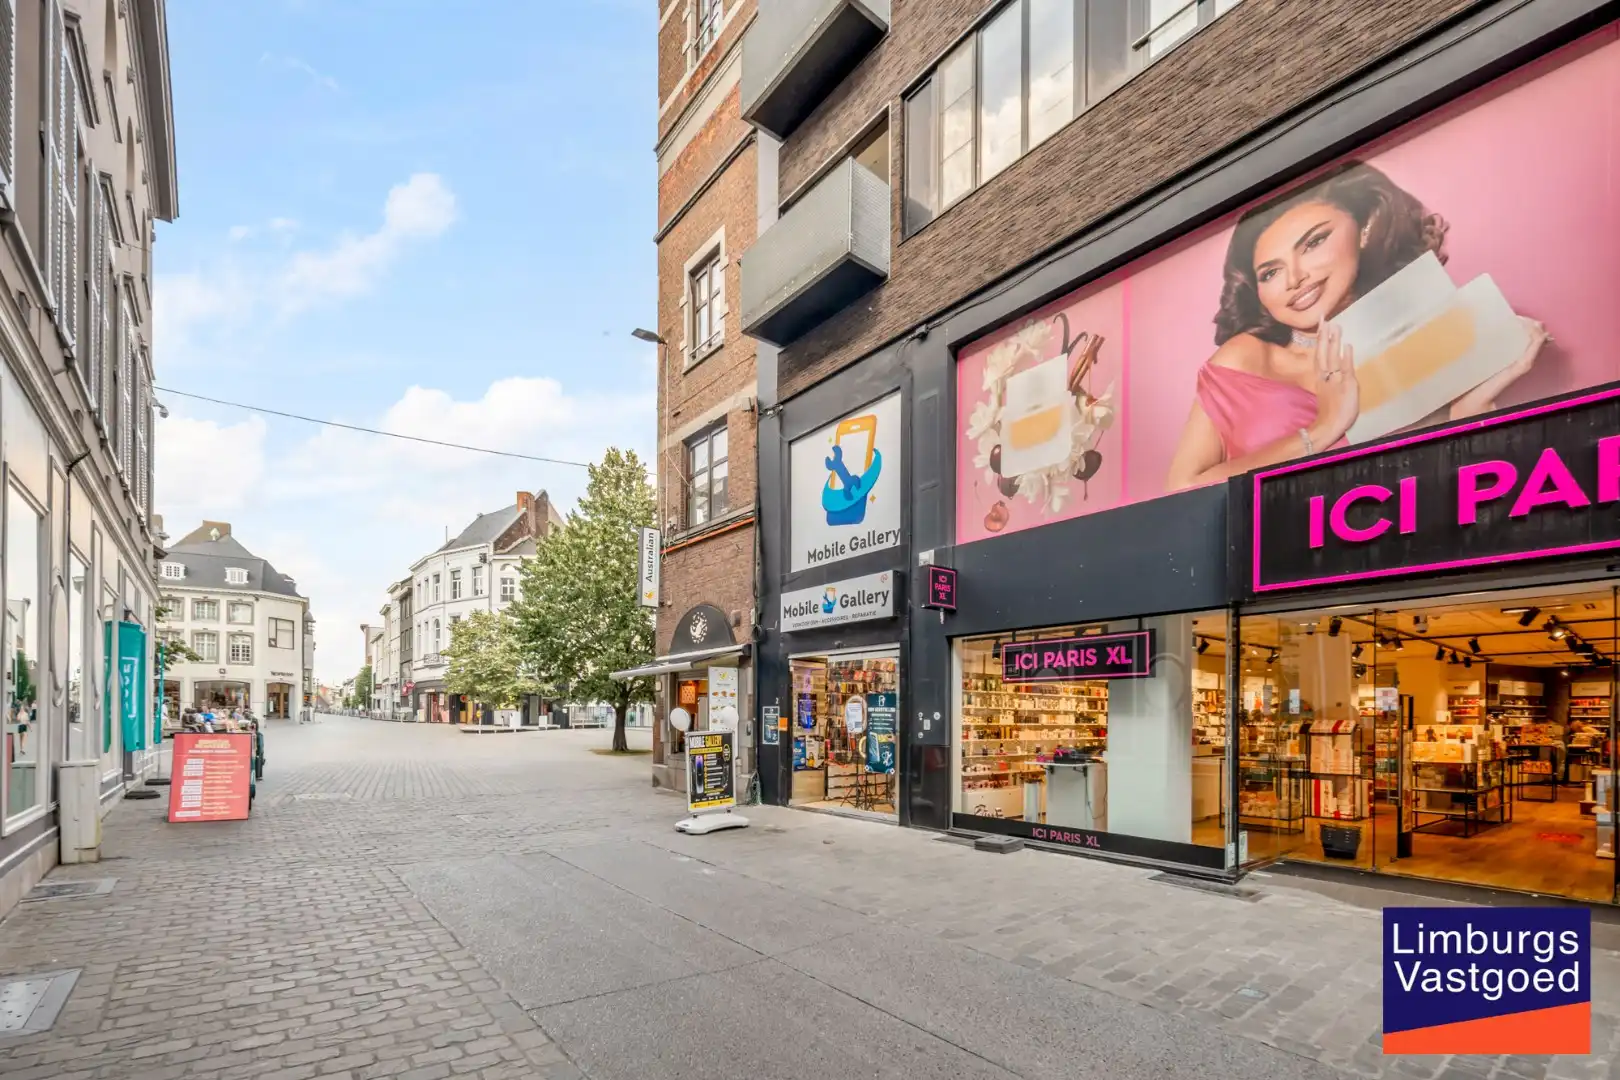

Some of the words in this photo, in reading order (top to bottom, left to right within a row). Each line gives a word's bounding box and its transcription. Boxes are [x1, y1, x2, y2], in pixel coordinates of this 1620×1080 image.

[1309, 475, 1417, 549] ICI
[645, 532, 655, 583] Australian
[807, 541, 846, 564] Mobile
[849, 528, 901, 552] Gallery
[934, 583, 951, 592] PARIS
[938, 575, 948, 583] ICI
[783, 600, 819, 619] Mobile
[840, 589, 890, 609] Gallery
[938, 592, 947, 600] XL
[1015, 652, 1038, 670] ICI
[1043, 648, 1098, 669] PARIS
[1105, 645, 1133, 665] XL
[1032, 827, 1047, 839] ICI
[1050, 830, 1081, 844] PARIS
[1085, 835, 1100, 847] XL
